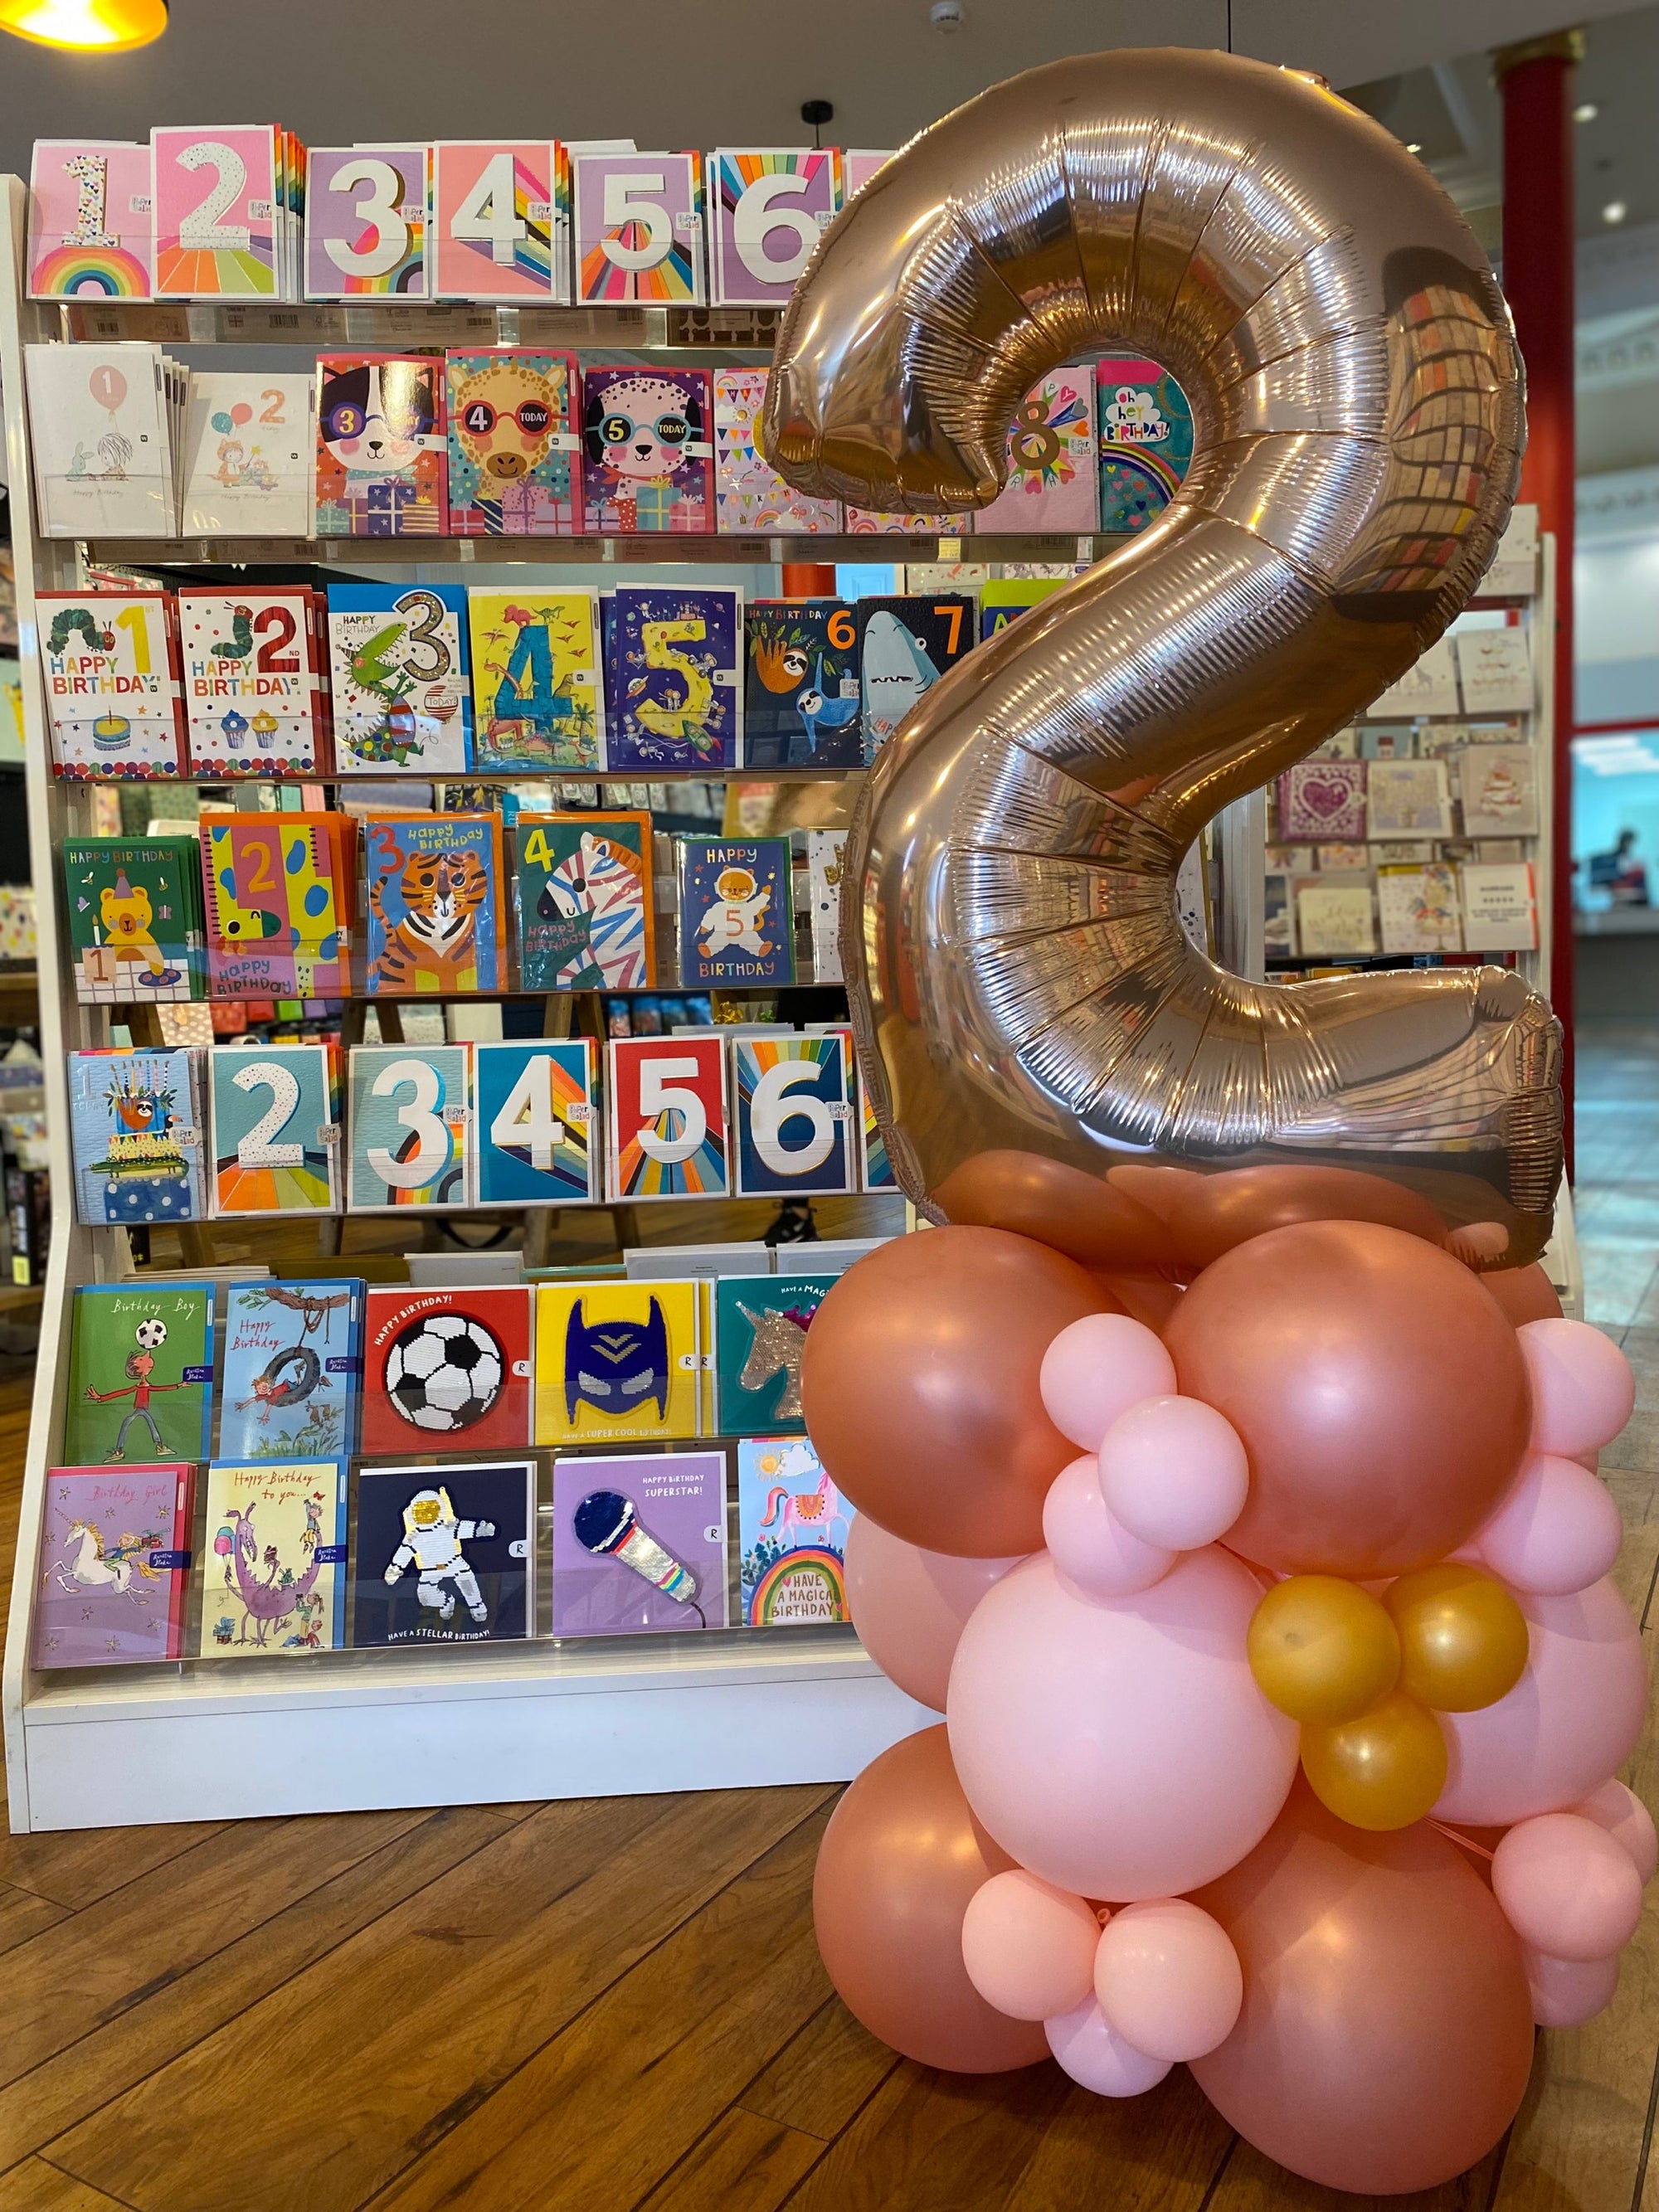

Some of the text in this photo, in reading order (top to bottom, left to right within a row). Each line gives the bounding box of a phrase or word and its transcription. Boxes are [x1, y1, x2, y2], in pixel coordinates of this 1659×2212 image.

[62, 155, 120, 246] 1
[176, 142, 250, 250] 2
[324, 159, 410, 277] 3
[450, 153, 526, 265] 4
[601, 174, 674, 271] 5
[733, 174, 821, 285] 6
[102, 372, 111, 393] 1
[259, 389, 285, 424] 2
[1119, 391, 1135, 403] Oh
[339, 411, 354, 433] 3
[469, 406, 548, 430] 4 TODAY
[608, 420, 686, 440] 5 TODAY
[1011, 401, 1060, 470] 8
[343, 615, 376, 624] HAPPY
[749, 609, 828, 620] HAPY BIRTHDAY
[395, 591, 450, 682] 3
[828, 610, 856, 649] 6
[934, 606, 963, 654] 7
[51, 656, 118, 674] HAPPY
[192, 660, 252, 676] HAPPY
[53, 675, 161, 694] BIRTHDAY
[194, 678, 301, 696] BIRTHDAY
[494, 625, 572, 732] 4
[635, 620, 713, 738] 5
[408, 824, 455, 840] Happy
[419, 828, 484, 850] BIRTHDay
[70, 850, 173, 863] HAPPY BIRTHDAY
[370, 825, 405, 874] 3
[524, 829, 555, 873] 4
[707, 848, 757, 863] HAPPY
[241, 841, 276, 893] 2
[528, 920, 576, 938] Happy
[726, 909, 744, 936] 5
[90, 950, 109, 981] 1
[219, 960, 270, 982] Happy
[699, 962, 775, 978] BIRTHDAY
[216, 975, 293, 995] BIRTHDay
[232, 1062, 306, 1169] 2
[491, 1054, 565, 1170] 4
[637, 1057, 707, 1164] 5
[751, 1060, 835, 1176] 6
[367, 1059, 454, 1189] 3
[111, 1298, 201, 1320] Birthday Boy
[241, 1319, 276, 1335] Happy
[374, 1295, 452, 1346] HAPPY BiRTHDAY!
[231, 1336, 285, 1351] Birthday
[518, 1363, 525, 1373] R
[685, 1356, 692, 1367] R
[701, 1356, 708, 1367] R
[586, 1429, 613, 1438] SUPER
[615, 1428, 637, 1437] COOL
[234, 1471, 321, 1489] Happy Birthday
[669, 1475, 704, 1483] BiRTHDAY
[85, 1485, 168, 1505] Birthday Girl
[261, 1490, 275, 1500] to
[645, 1486, 703, 1497] SUPERSTAR!
[711, 1529, 718, 1539] R
[516, 1544, 523, 1554] R
[794, 1574, 822, 1587] HAVE
[777, 1589, 837, 1603] A MAGICAL
[771, 1602, 834, 1618] BIRTHDAY
[387, 1631, 407, 1641] HAVE
[416, 1628, 454, 1640] STELLAR
